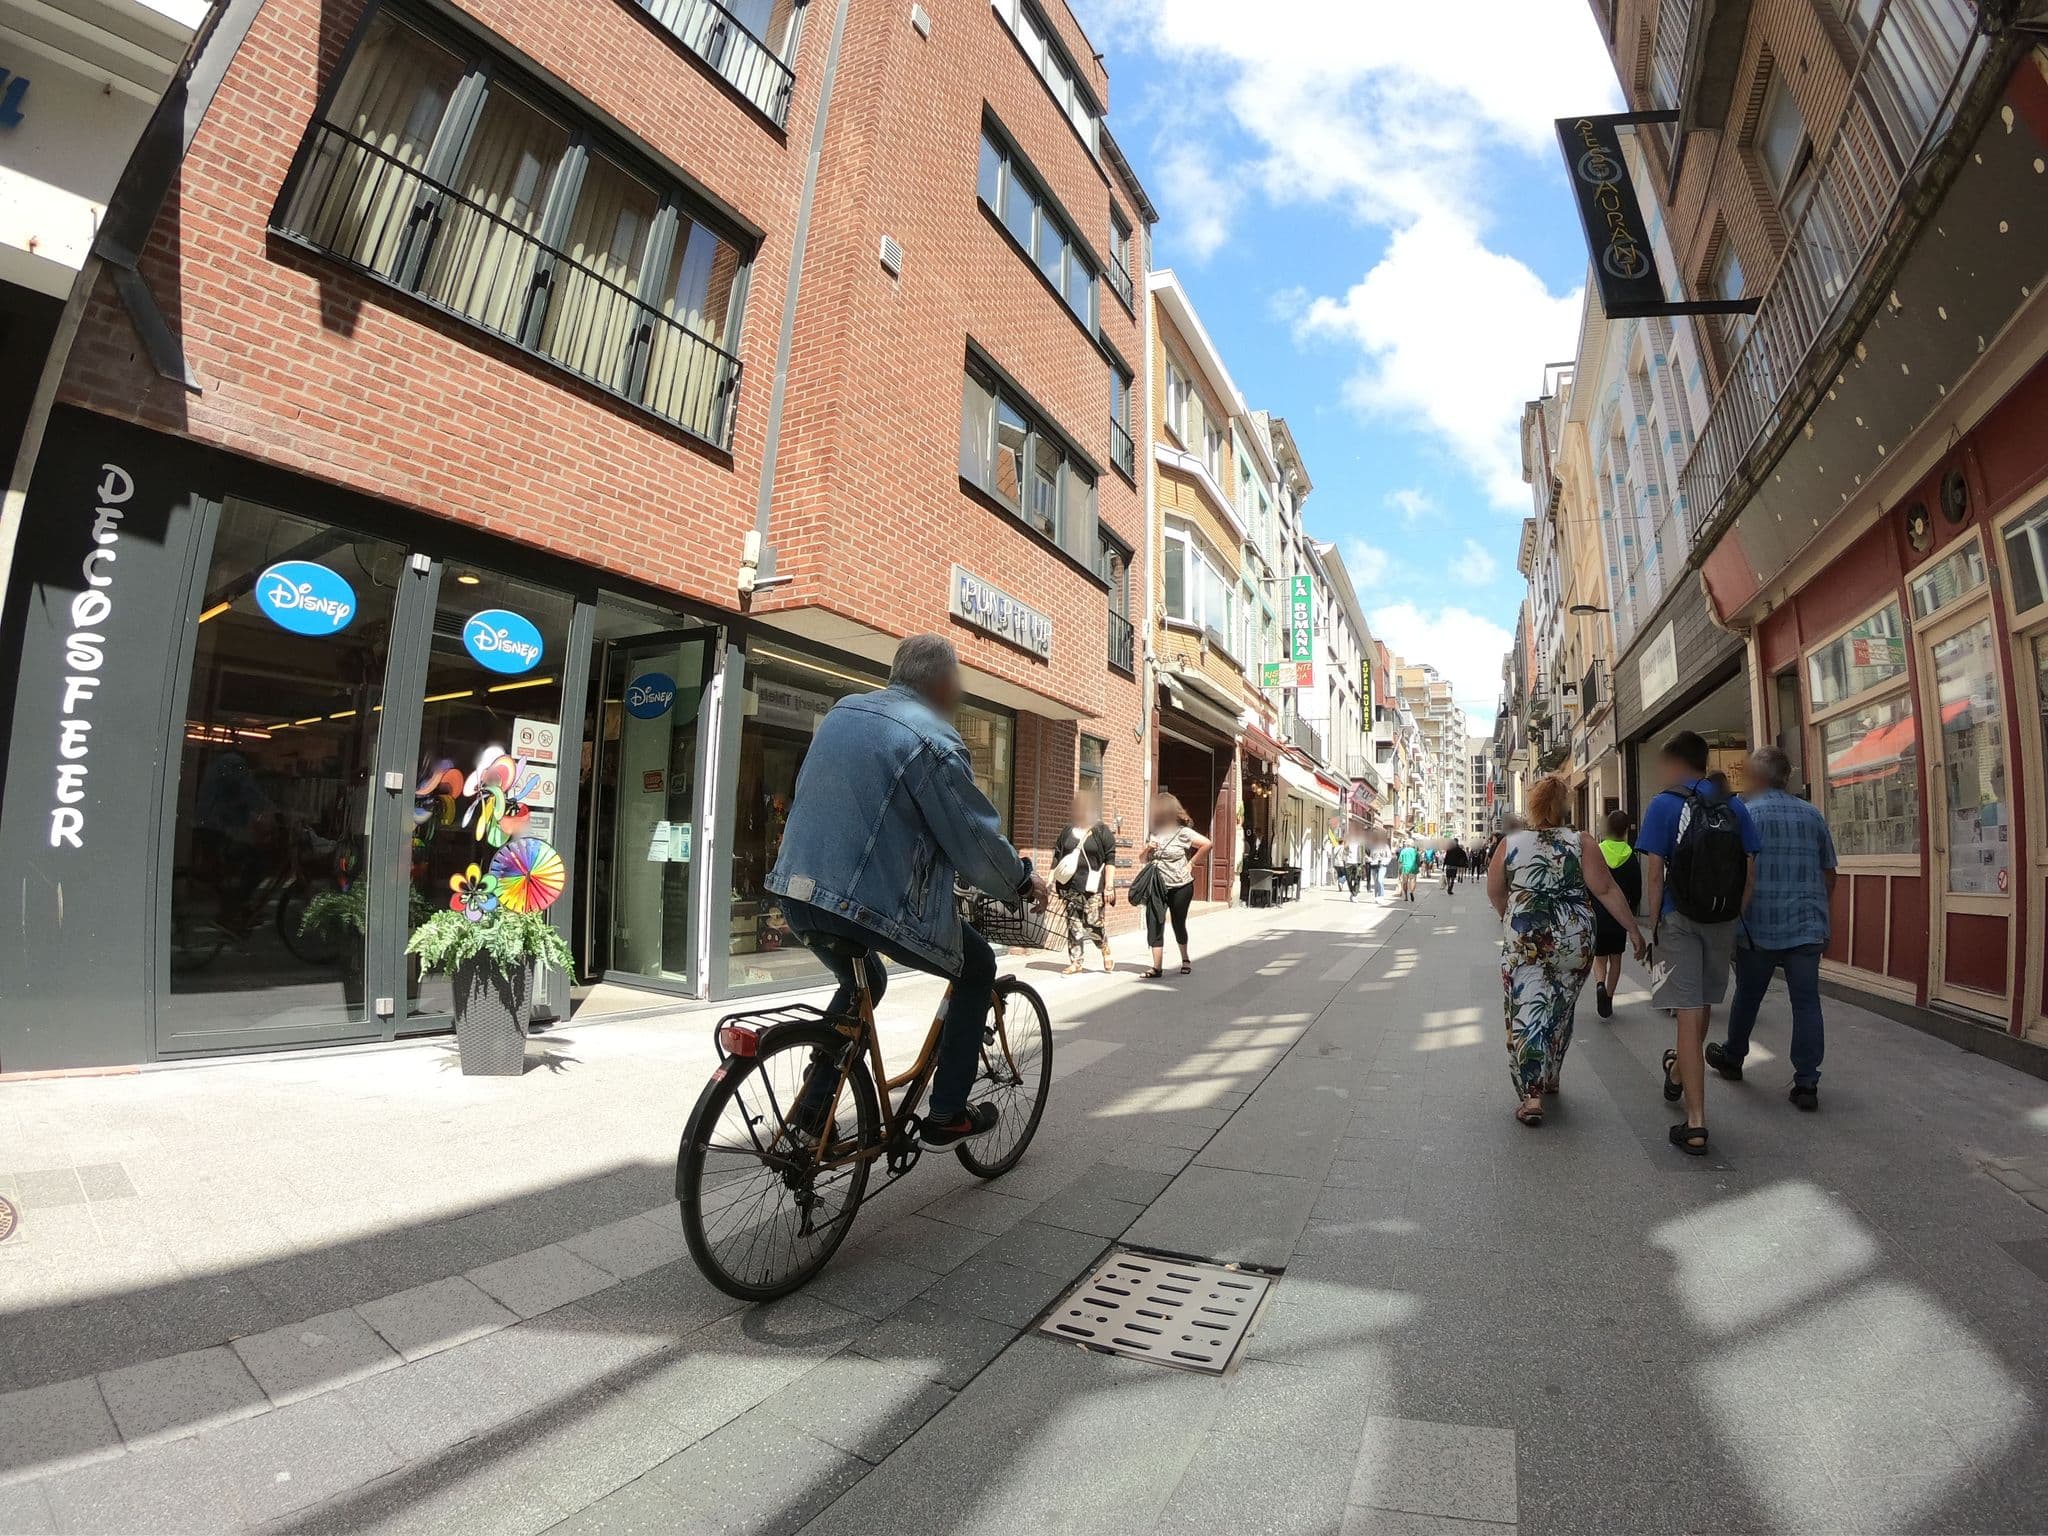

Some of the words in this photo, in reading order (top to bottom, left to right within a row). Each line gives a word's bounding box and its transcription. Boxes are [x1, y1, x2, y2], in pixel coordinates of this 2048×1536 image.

[1295, 578, 1308, 597] LA
[50, 463, 135, 849] DECOSFEER
[1294, 602, 1310, 657] ROMANA
